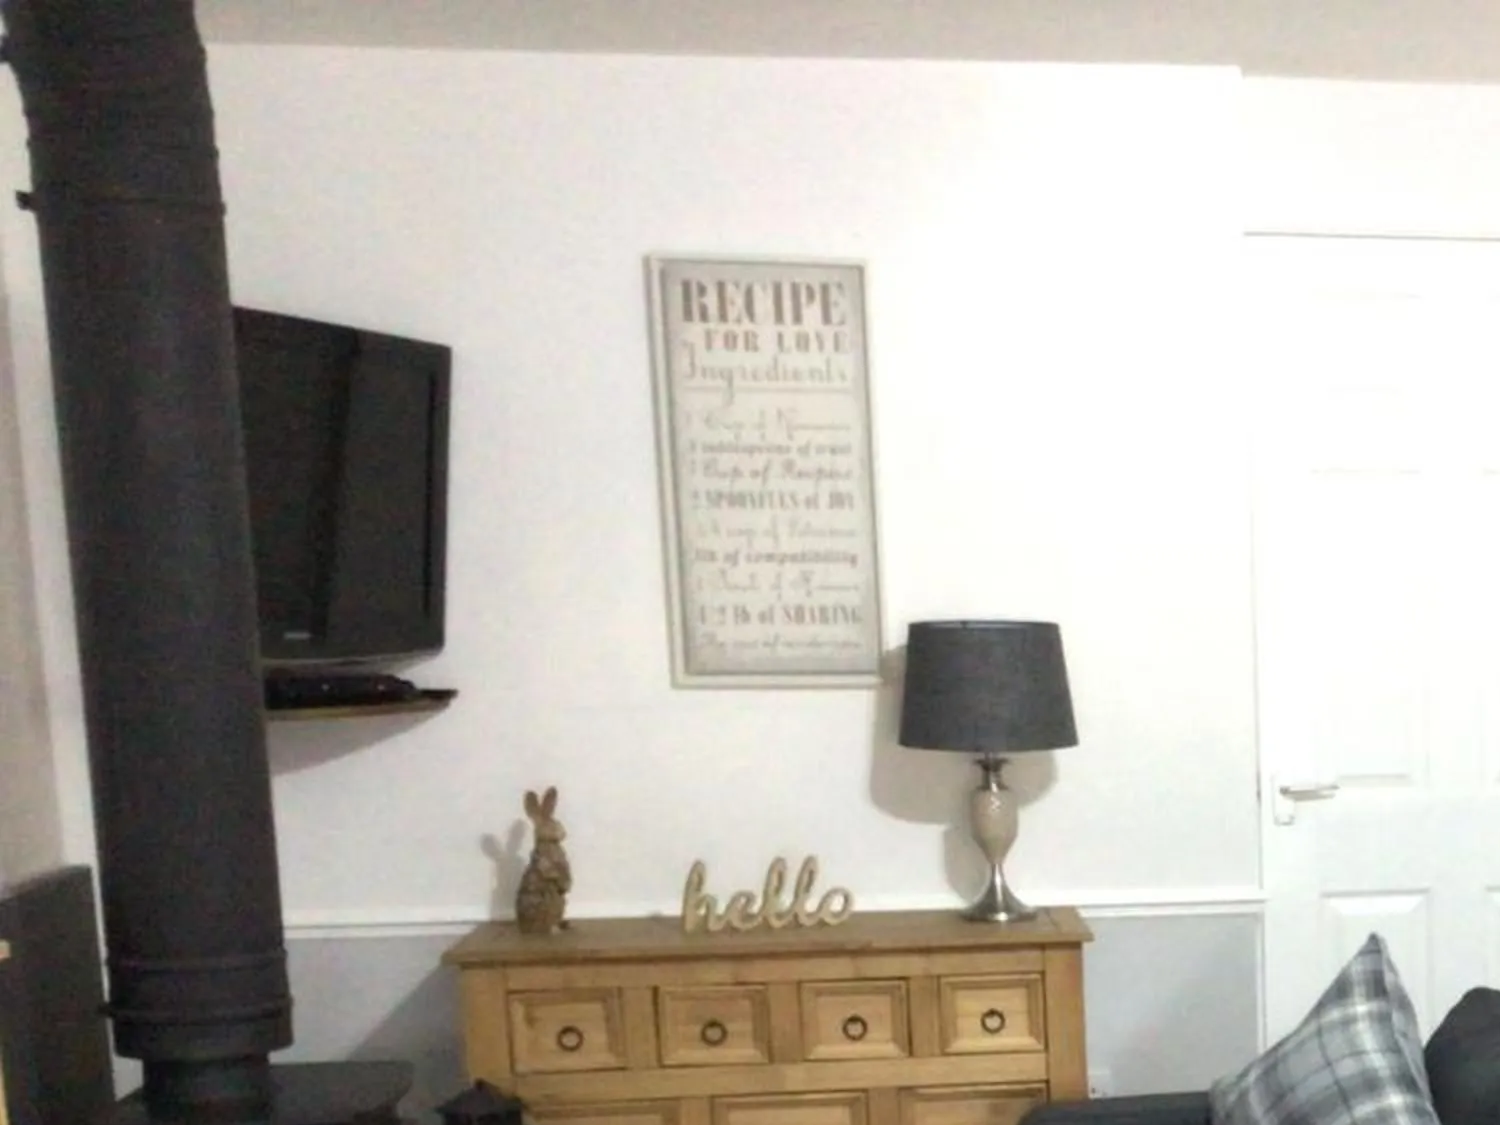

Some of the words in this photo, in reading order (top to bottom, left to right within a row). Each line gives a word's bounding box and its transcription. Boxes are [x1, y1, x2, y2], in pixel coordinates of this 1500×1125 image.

[681, 280, 846, 325] RECIPE
[704, 328, 760, 352] FOR
[777, 330, 849, 354] LOVE
[682, 855, 853, 933] hello
